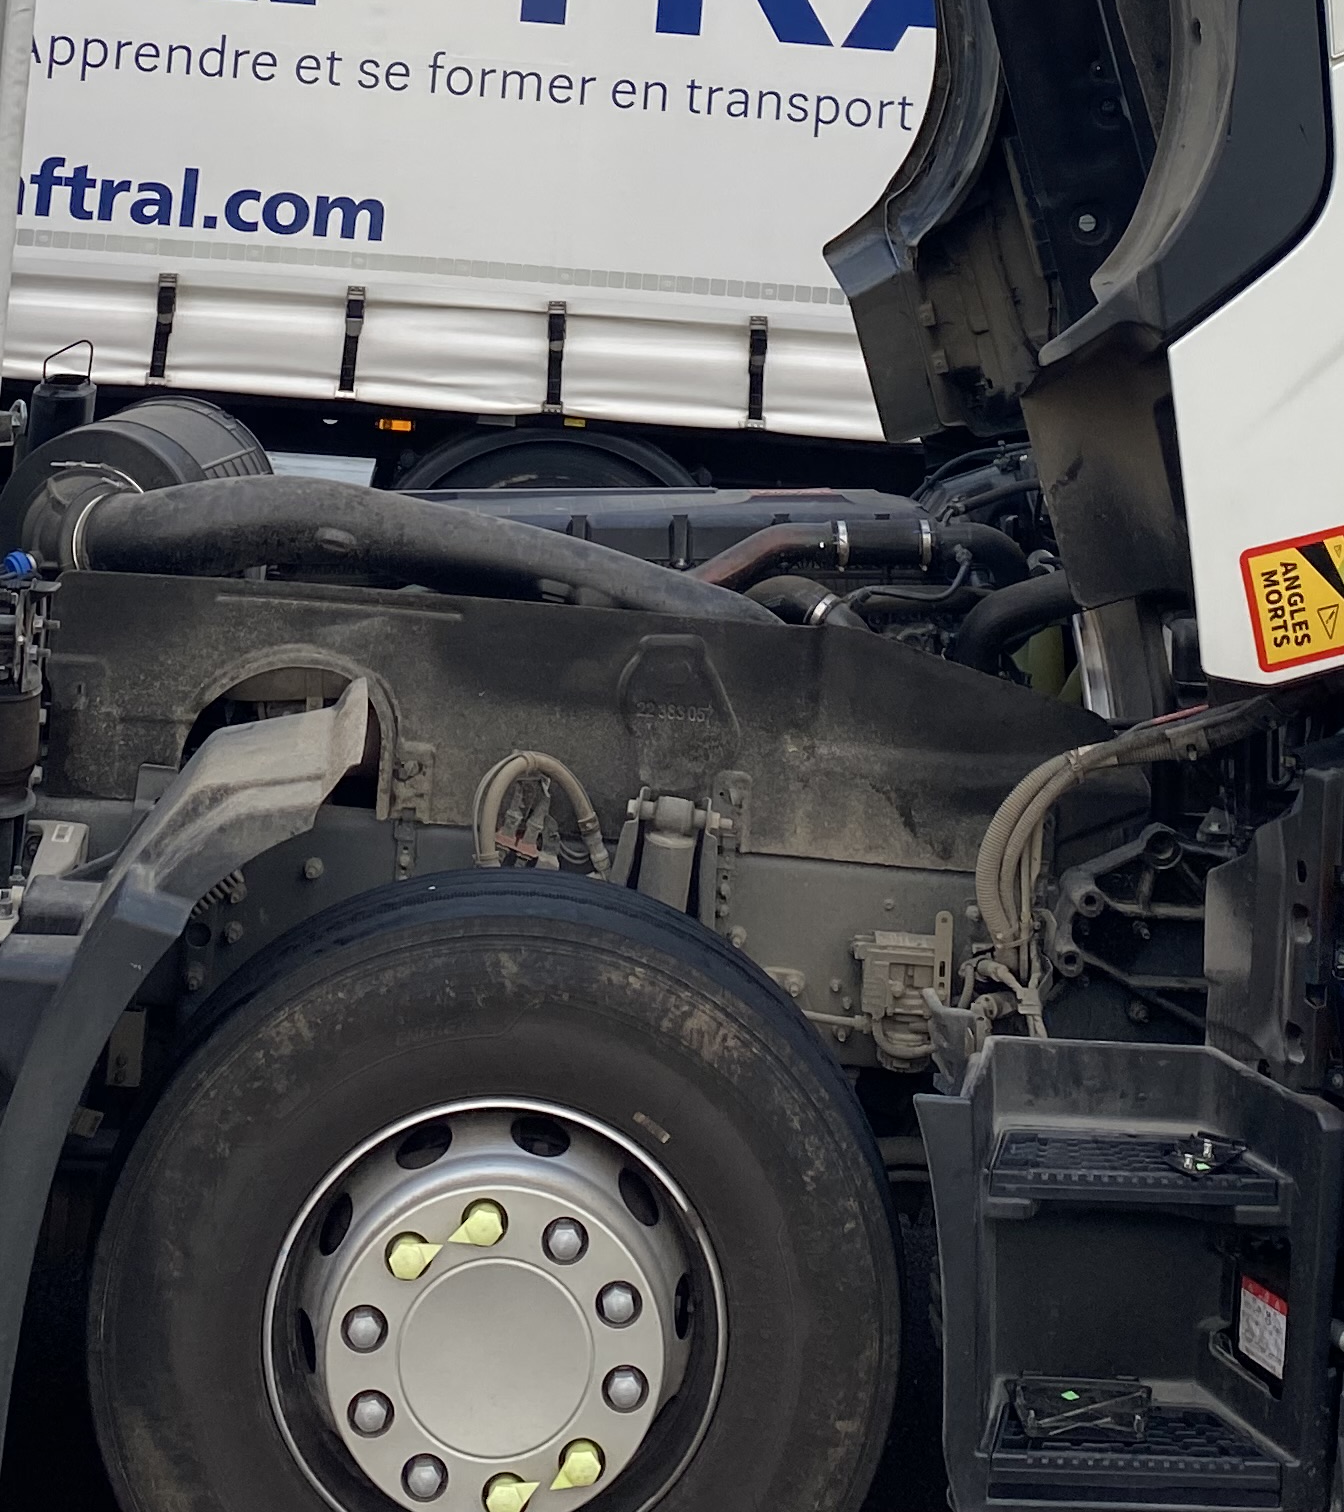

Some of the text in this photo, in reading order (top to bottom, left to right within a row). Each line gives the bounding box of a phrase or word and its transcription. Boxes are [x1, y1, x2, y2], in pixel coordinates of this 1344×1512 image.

[295, 51, 341, 87] et
[357, 59, 410, 91] se
[429, 51, 596, 105] former
[612, 77, 667, 112] en
[686, 78, 913, 138] transport
[1261, 569, 1290, 648] MORTS
[1279, 561, 1311, 646] ANGLES
